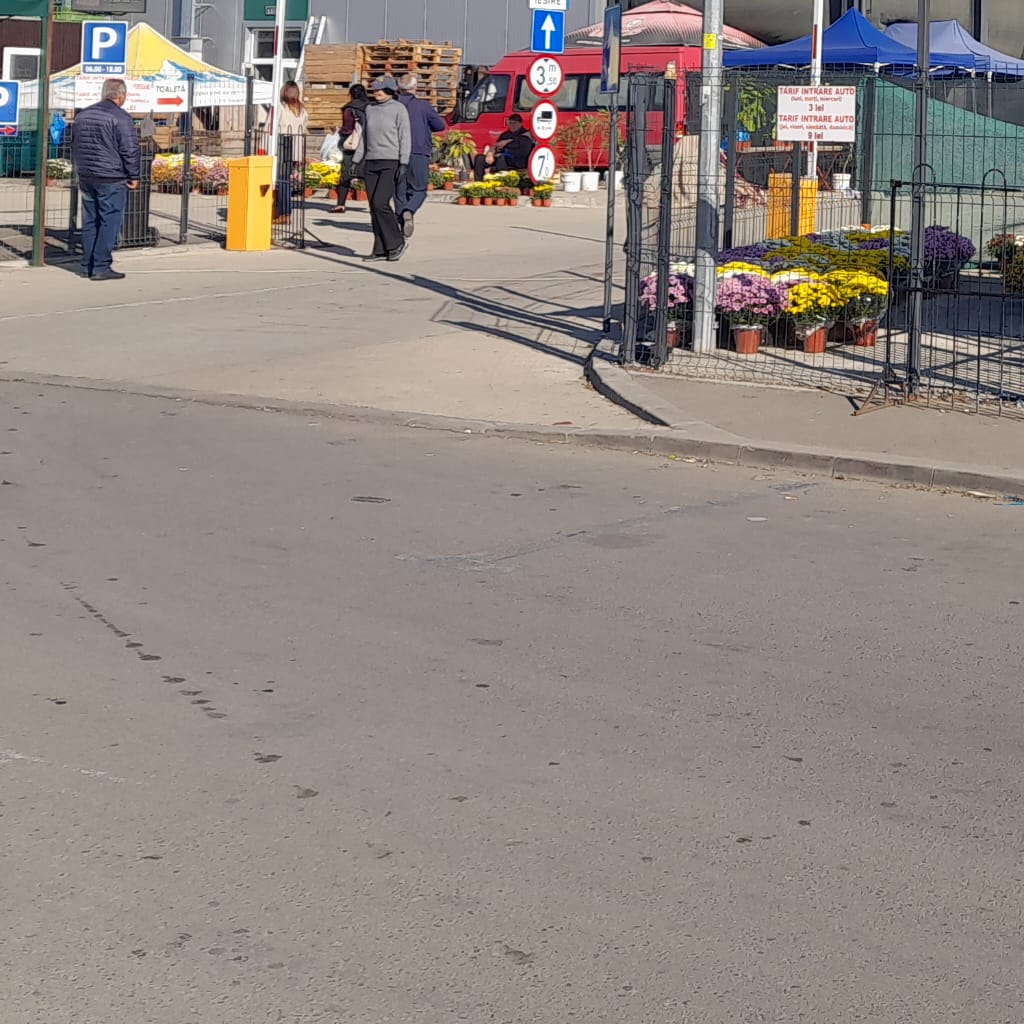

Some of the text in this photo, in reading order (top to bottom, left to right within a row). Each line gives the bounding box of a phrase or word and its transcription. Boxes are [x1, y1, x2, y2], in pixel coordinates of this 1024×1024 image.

[92, 27, 117, 59] P
[780, 87, 800, 95] TARIF
[801, 87, 833, 95] INTRARE
[801, 115, 832, 123] INTRARE
[835, 115, 854, 123] AUTO
